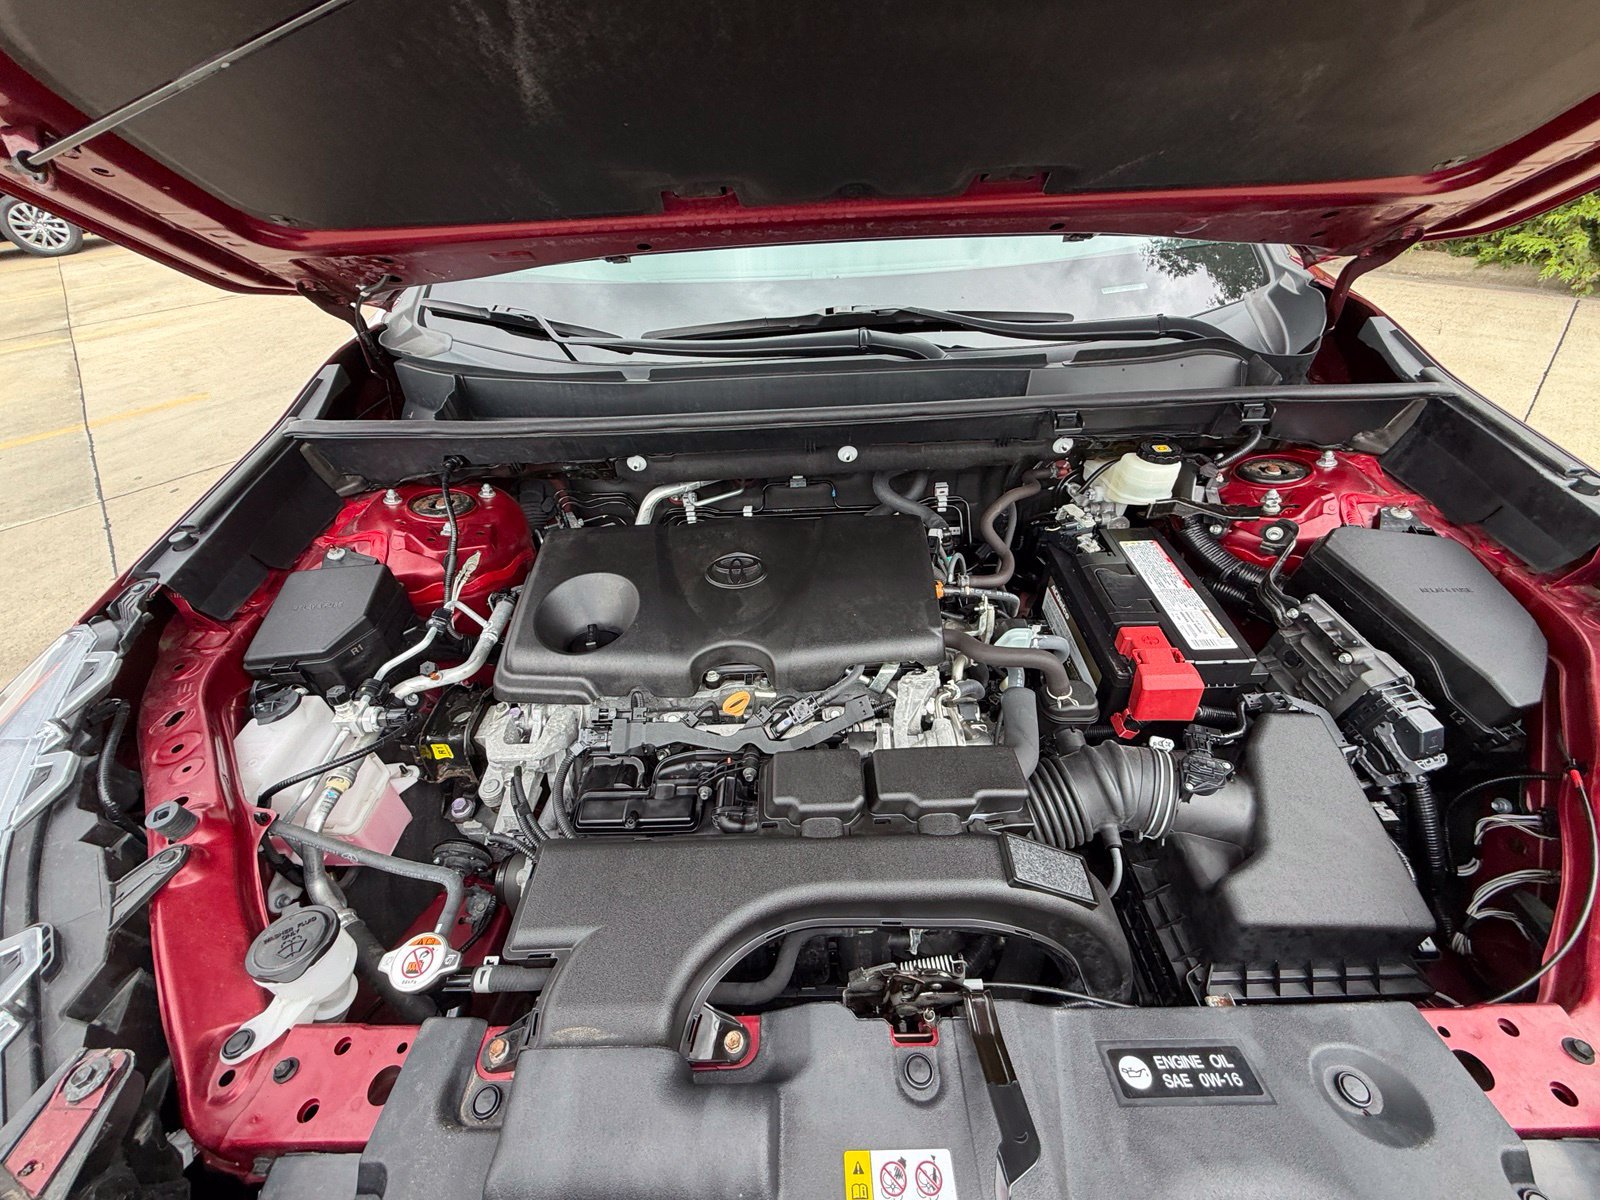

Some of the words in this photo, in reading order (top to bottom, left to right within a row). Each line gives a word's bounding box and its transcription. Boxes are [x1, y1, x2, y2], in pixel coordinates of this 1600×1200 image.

[350, 644, 364, 656] R1
[263, 927, 294, 944] WASHER
[297, 916, 317, 928] FLUID
[281, 929, 300, 941] ONLY
[1153, 1055, 1205, 1069] ENGINE
[1208, 1054, 1235, 1068] OIL
[1162, 1073, 1193, 1088] SAE
[1198, 1073, 1244, 1087] 0W-16
